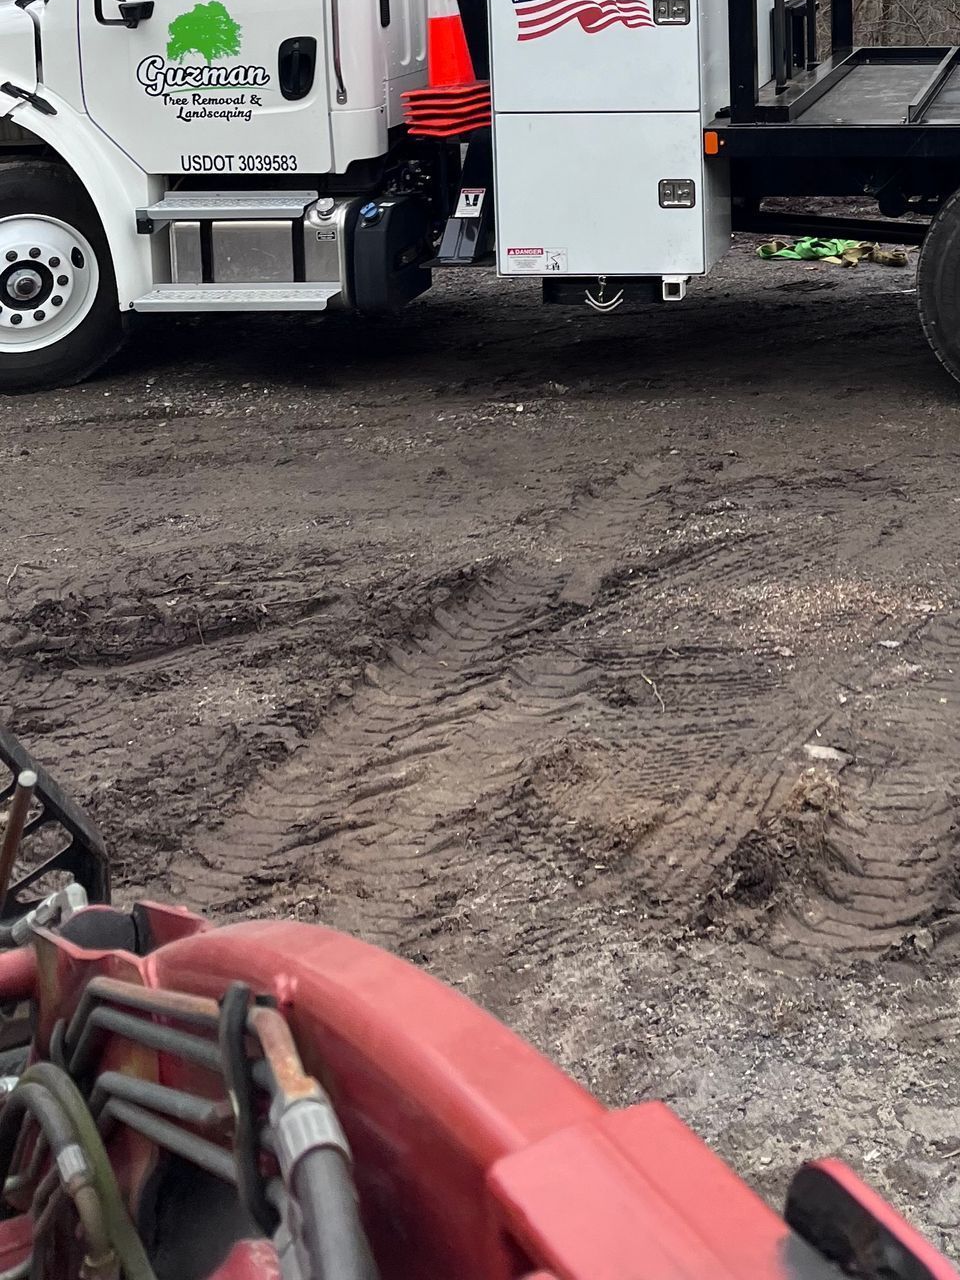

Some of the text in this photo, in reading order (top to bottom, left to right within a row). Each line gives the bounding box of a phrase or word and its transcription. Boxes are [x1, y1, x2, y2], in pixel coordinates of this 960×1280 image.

[136, 54, 271, 97] Guzman
[162, 93, 263, 107] Tree Removal &
[175, 106, 253, 122] Landscaping
[180, 154, 298, 172] USDOT 3039583
[514, 248, 543, 256] DANGER
